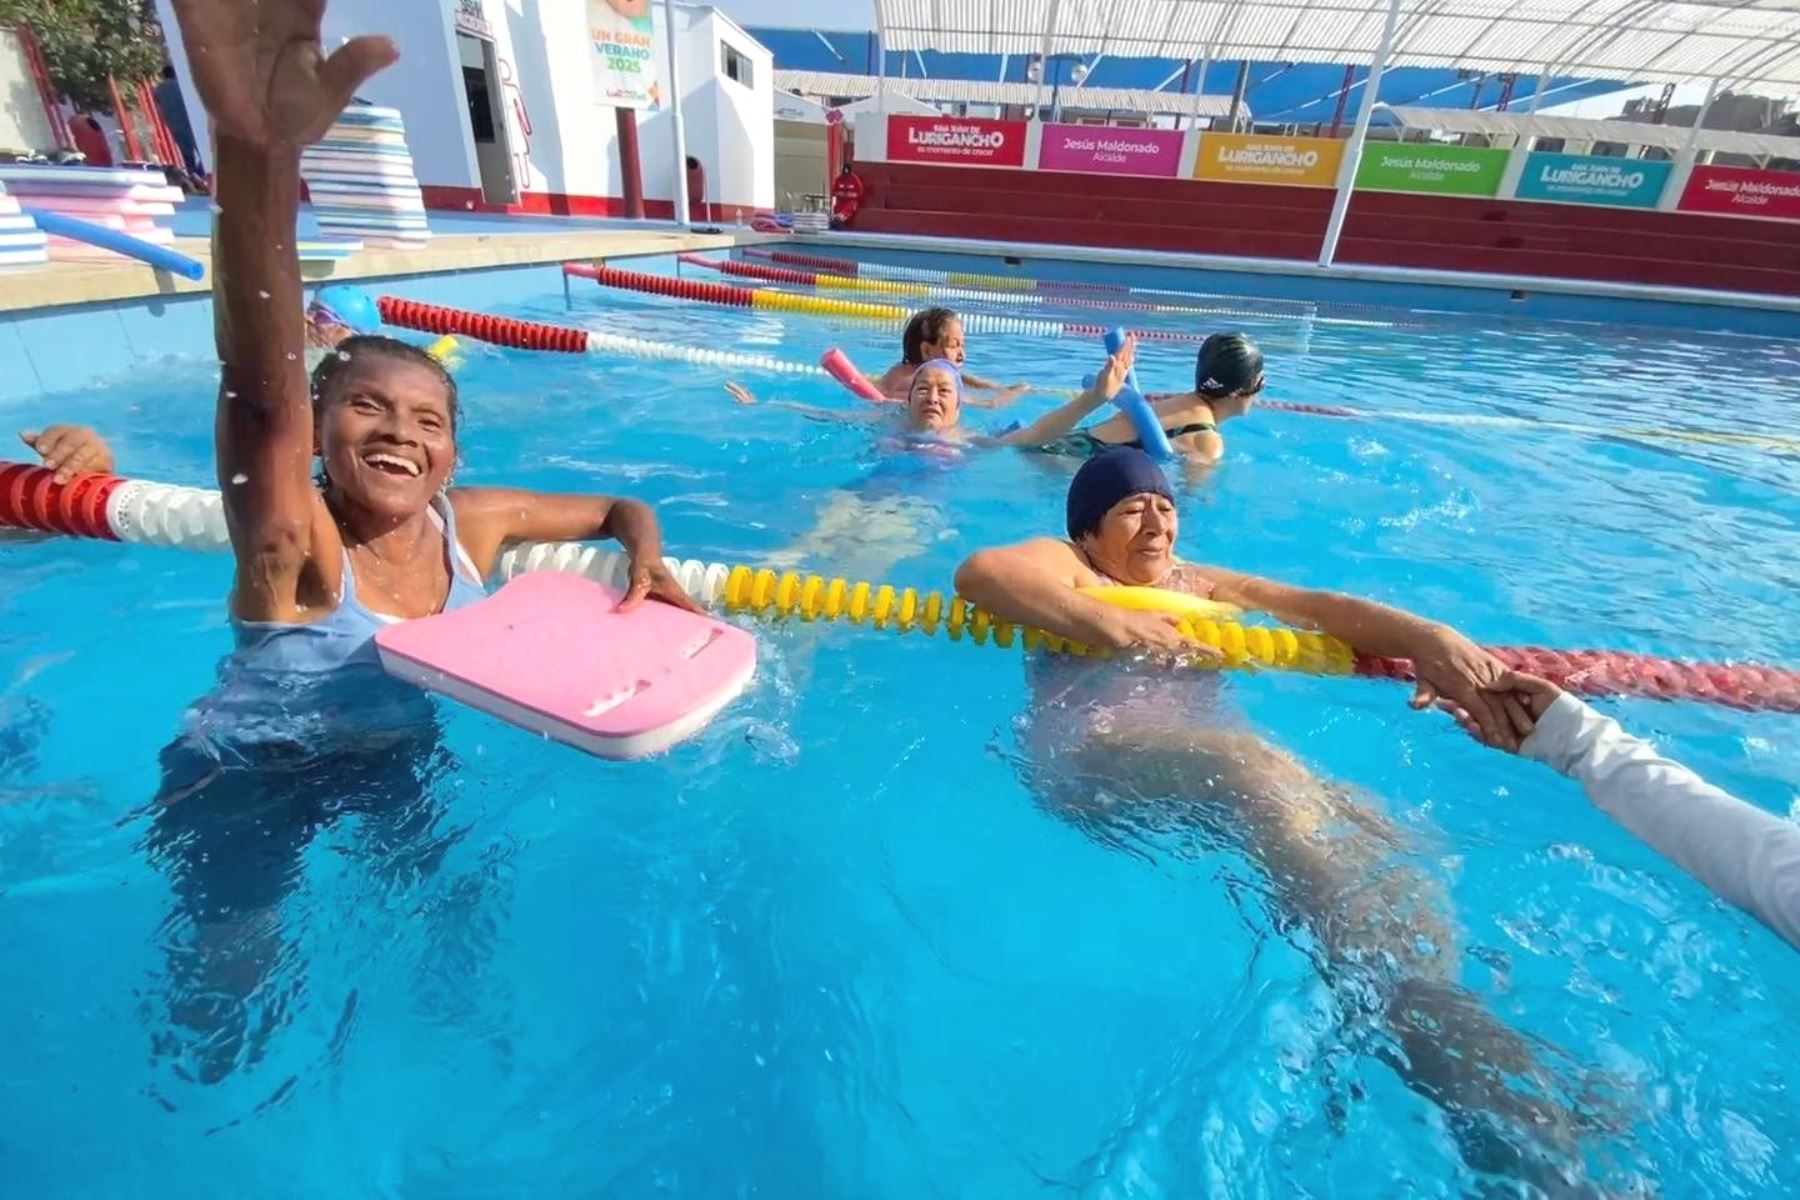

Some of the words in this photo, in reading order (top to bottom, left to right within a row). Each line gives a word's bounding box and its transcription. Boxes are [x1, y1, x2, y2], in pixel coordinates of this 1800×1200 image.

[591, 28, 611, 41] UN
[614, 31, 651, 48] GRAN
[594, 42, 650, 61] VERANO
[607, 57, 642, 74] 2025
[1063, 138, 1096, 151] Jesús
[1097, 140, 1160, 154] Maldonado
[1092, 152, 1127, 163] Alcalde
[1381, 156, 1413, 168] Jesús
[1414, 158, 1480, 173] Maldonado
